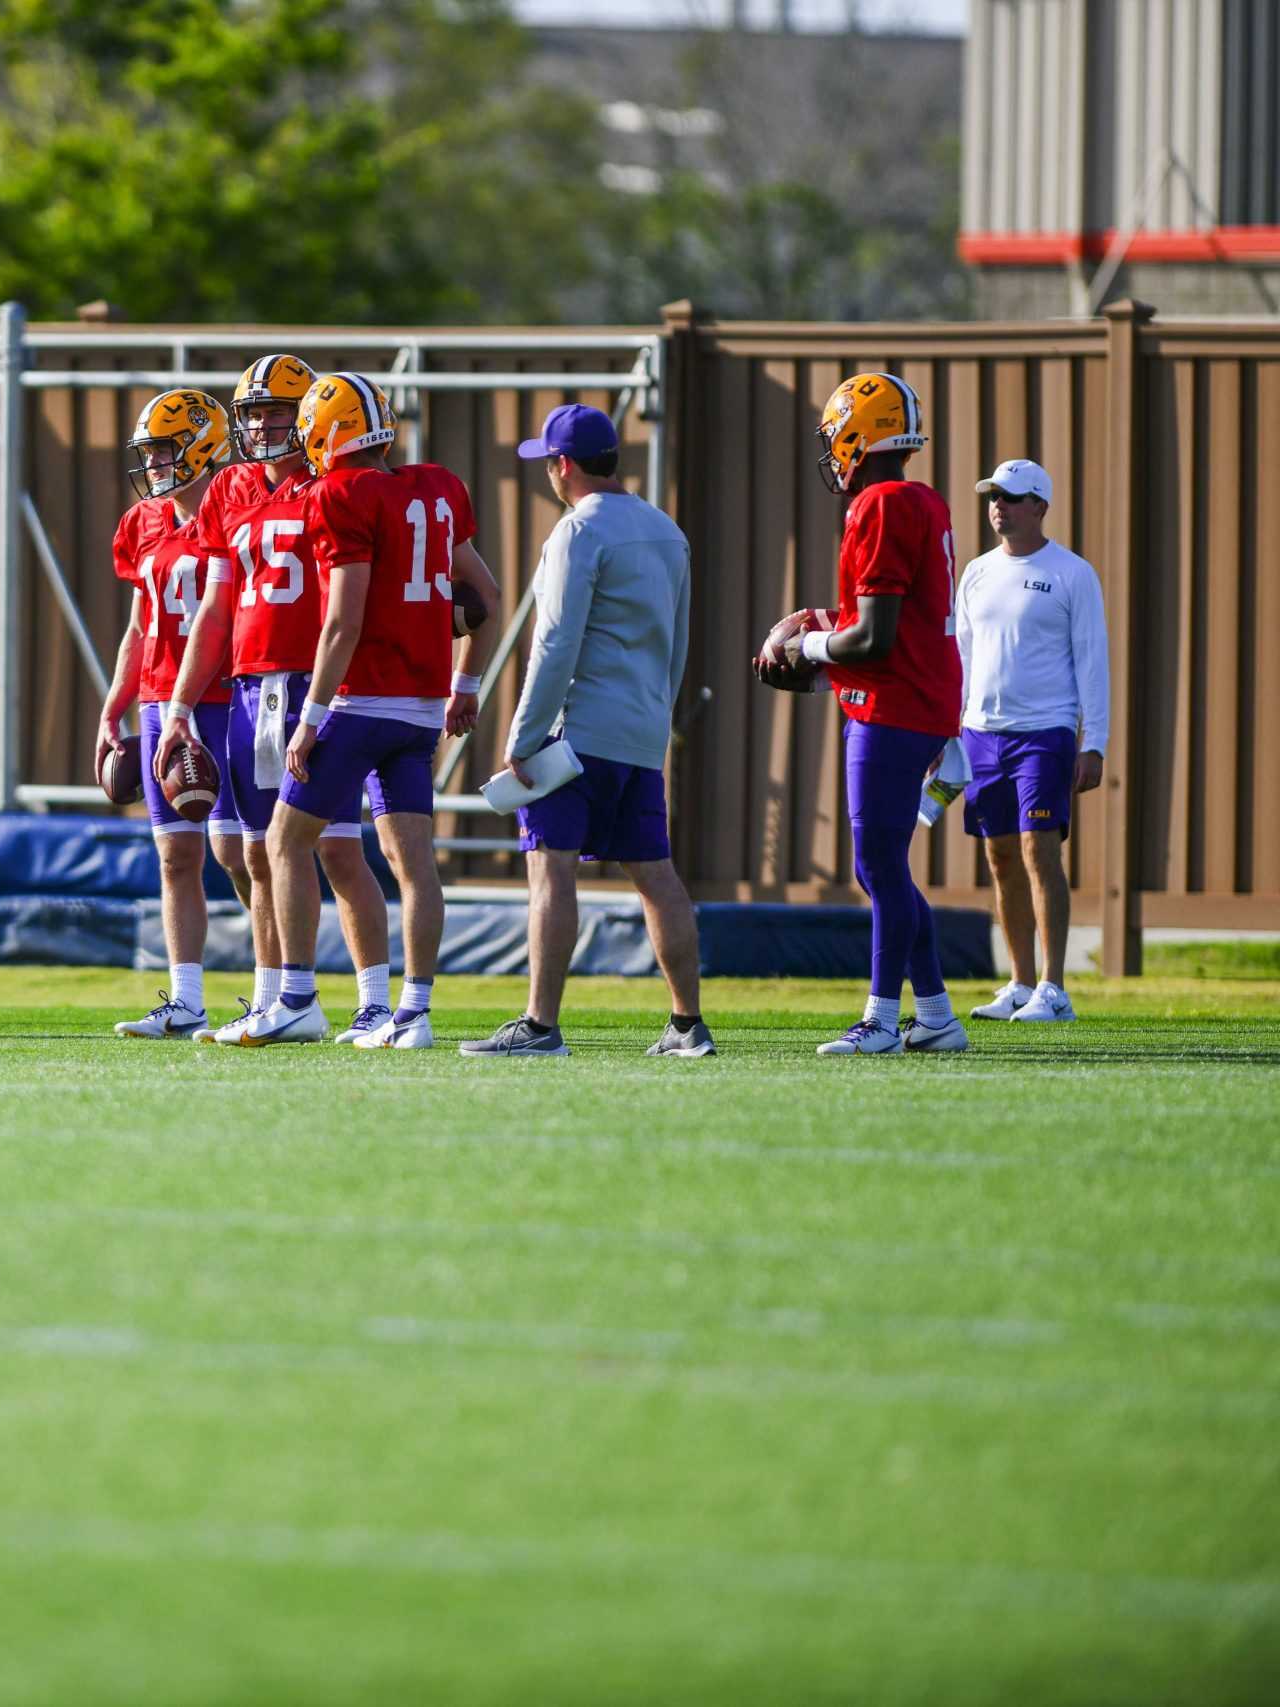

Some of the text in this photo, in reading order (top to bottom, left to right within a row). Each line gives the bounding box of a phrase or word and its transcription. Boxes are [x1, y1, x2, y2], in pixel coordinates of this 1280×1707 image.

[228, 519, 305, 608] 15
[403, 497, 454, 602] 13
[1024, 580, 1051, 593] LSU
[139, 554, 204, 638] 14
